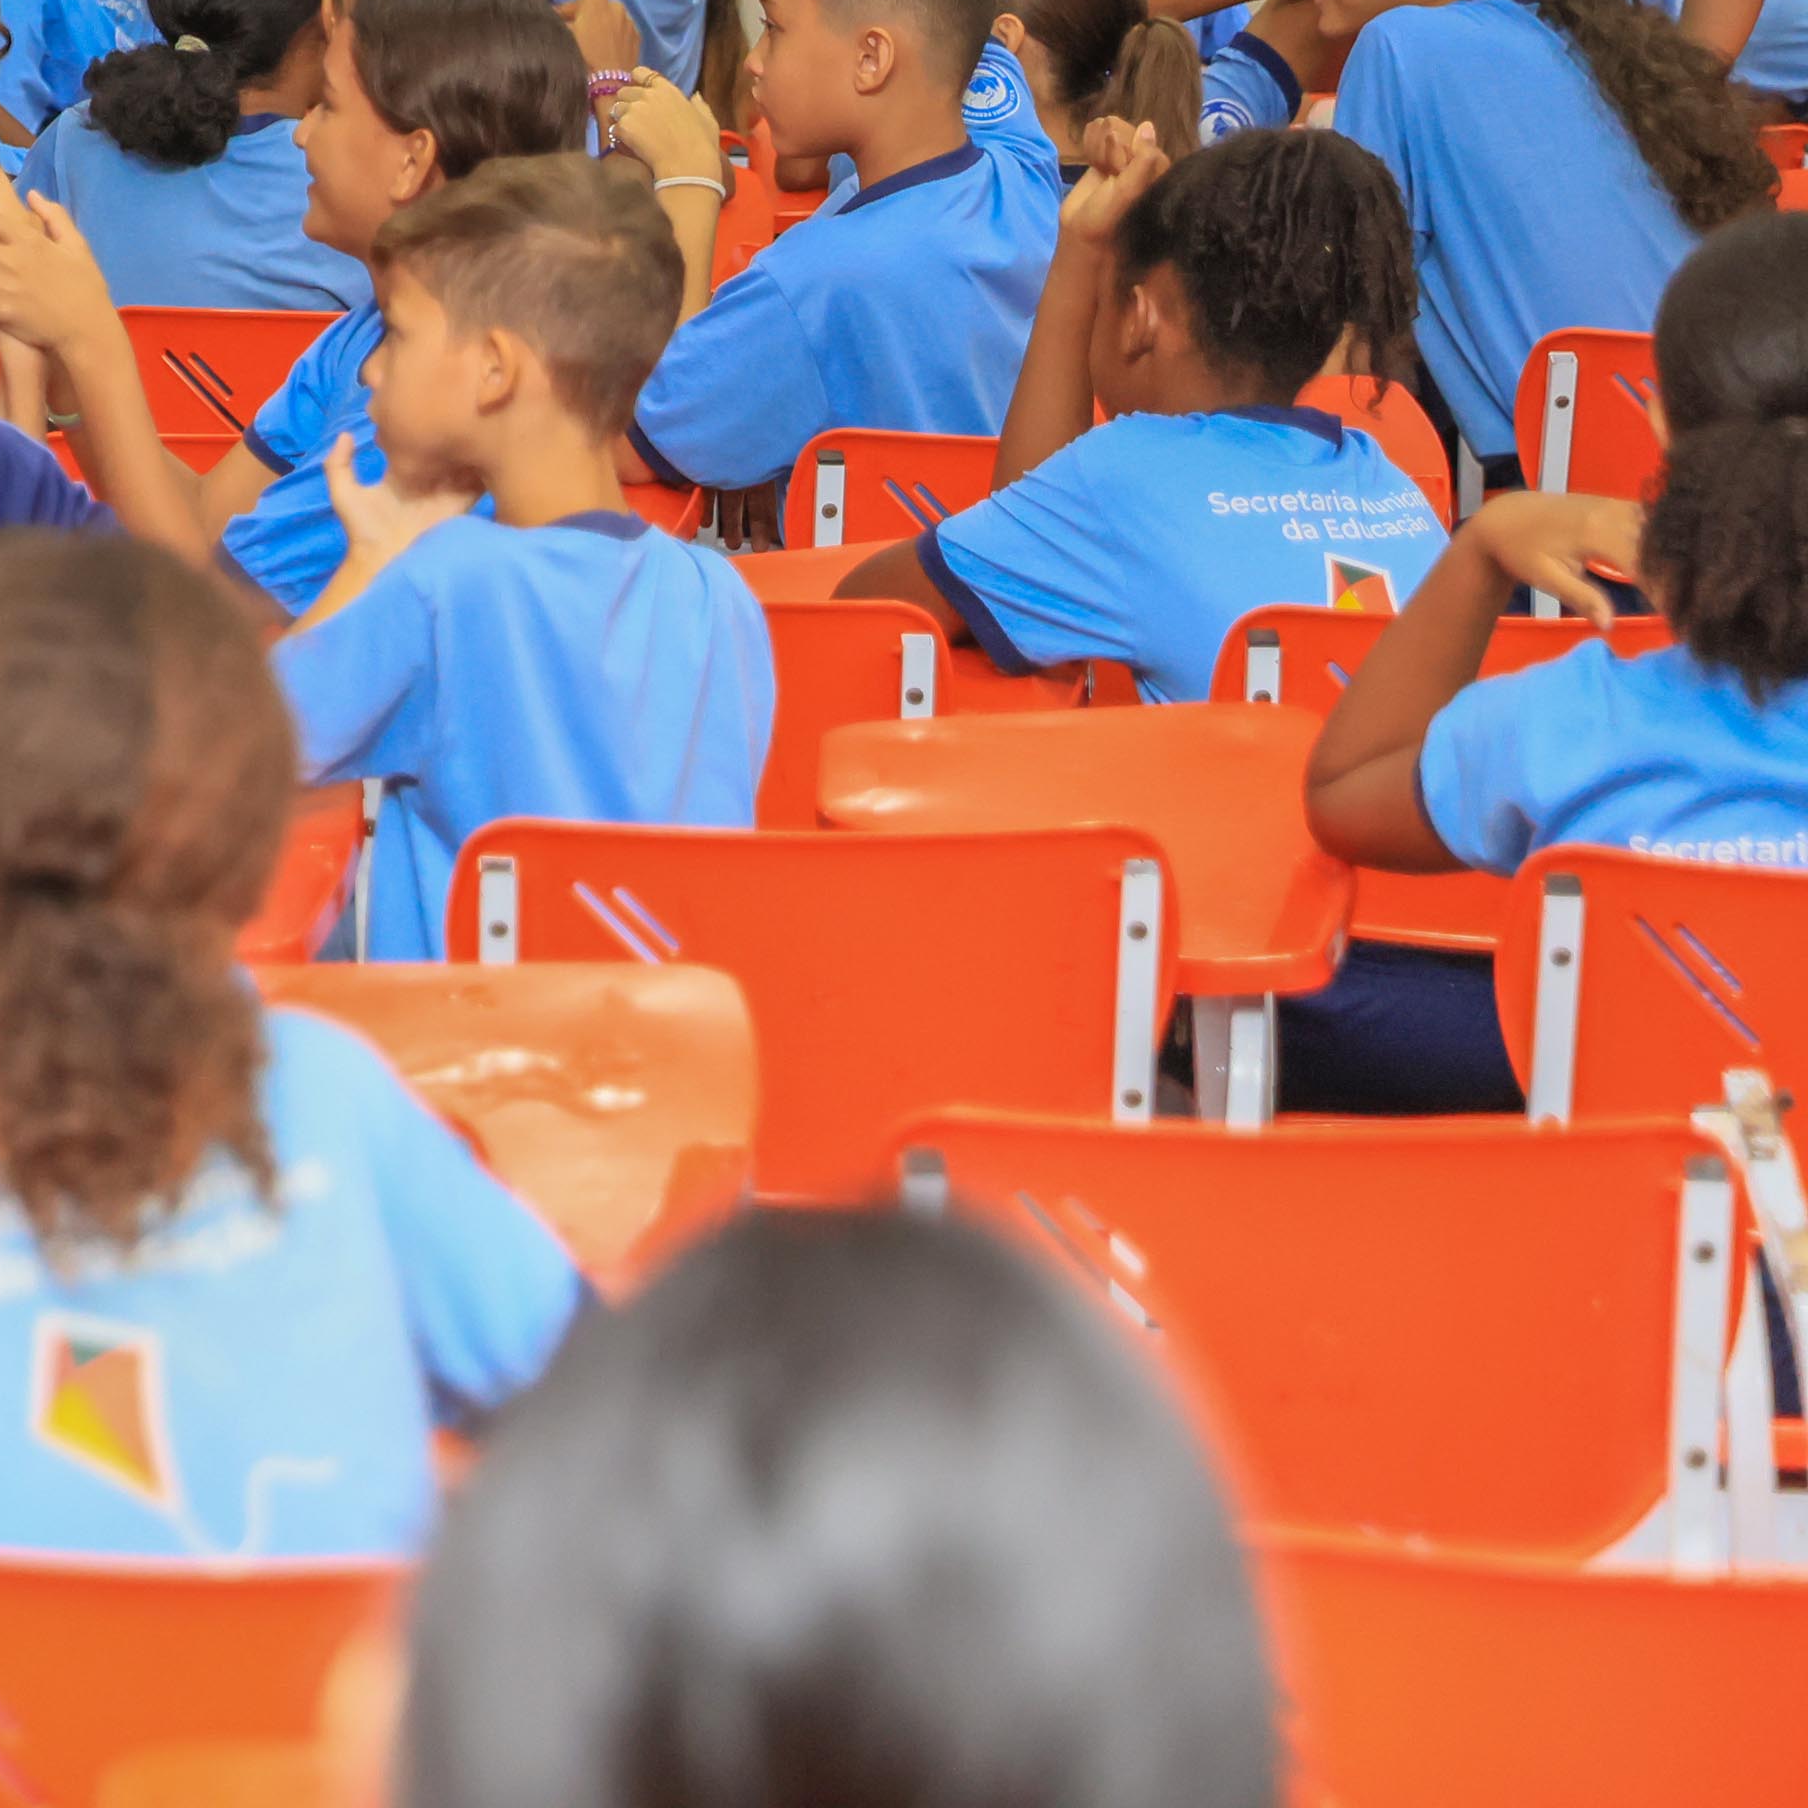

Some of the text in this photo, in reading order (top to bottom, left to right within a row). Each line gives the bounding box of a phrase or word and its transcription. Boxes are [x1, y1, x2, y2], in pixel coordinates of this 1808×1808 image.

[1207, 489, 1358, 514] Secretaria
[1282, 517, 1320, 541] da
[1628, 832, 1808, 864] Secretari
